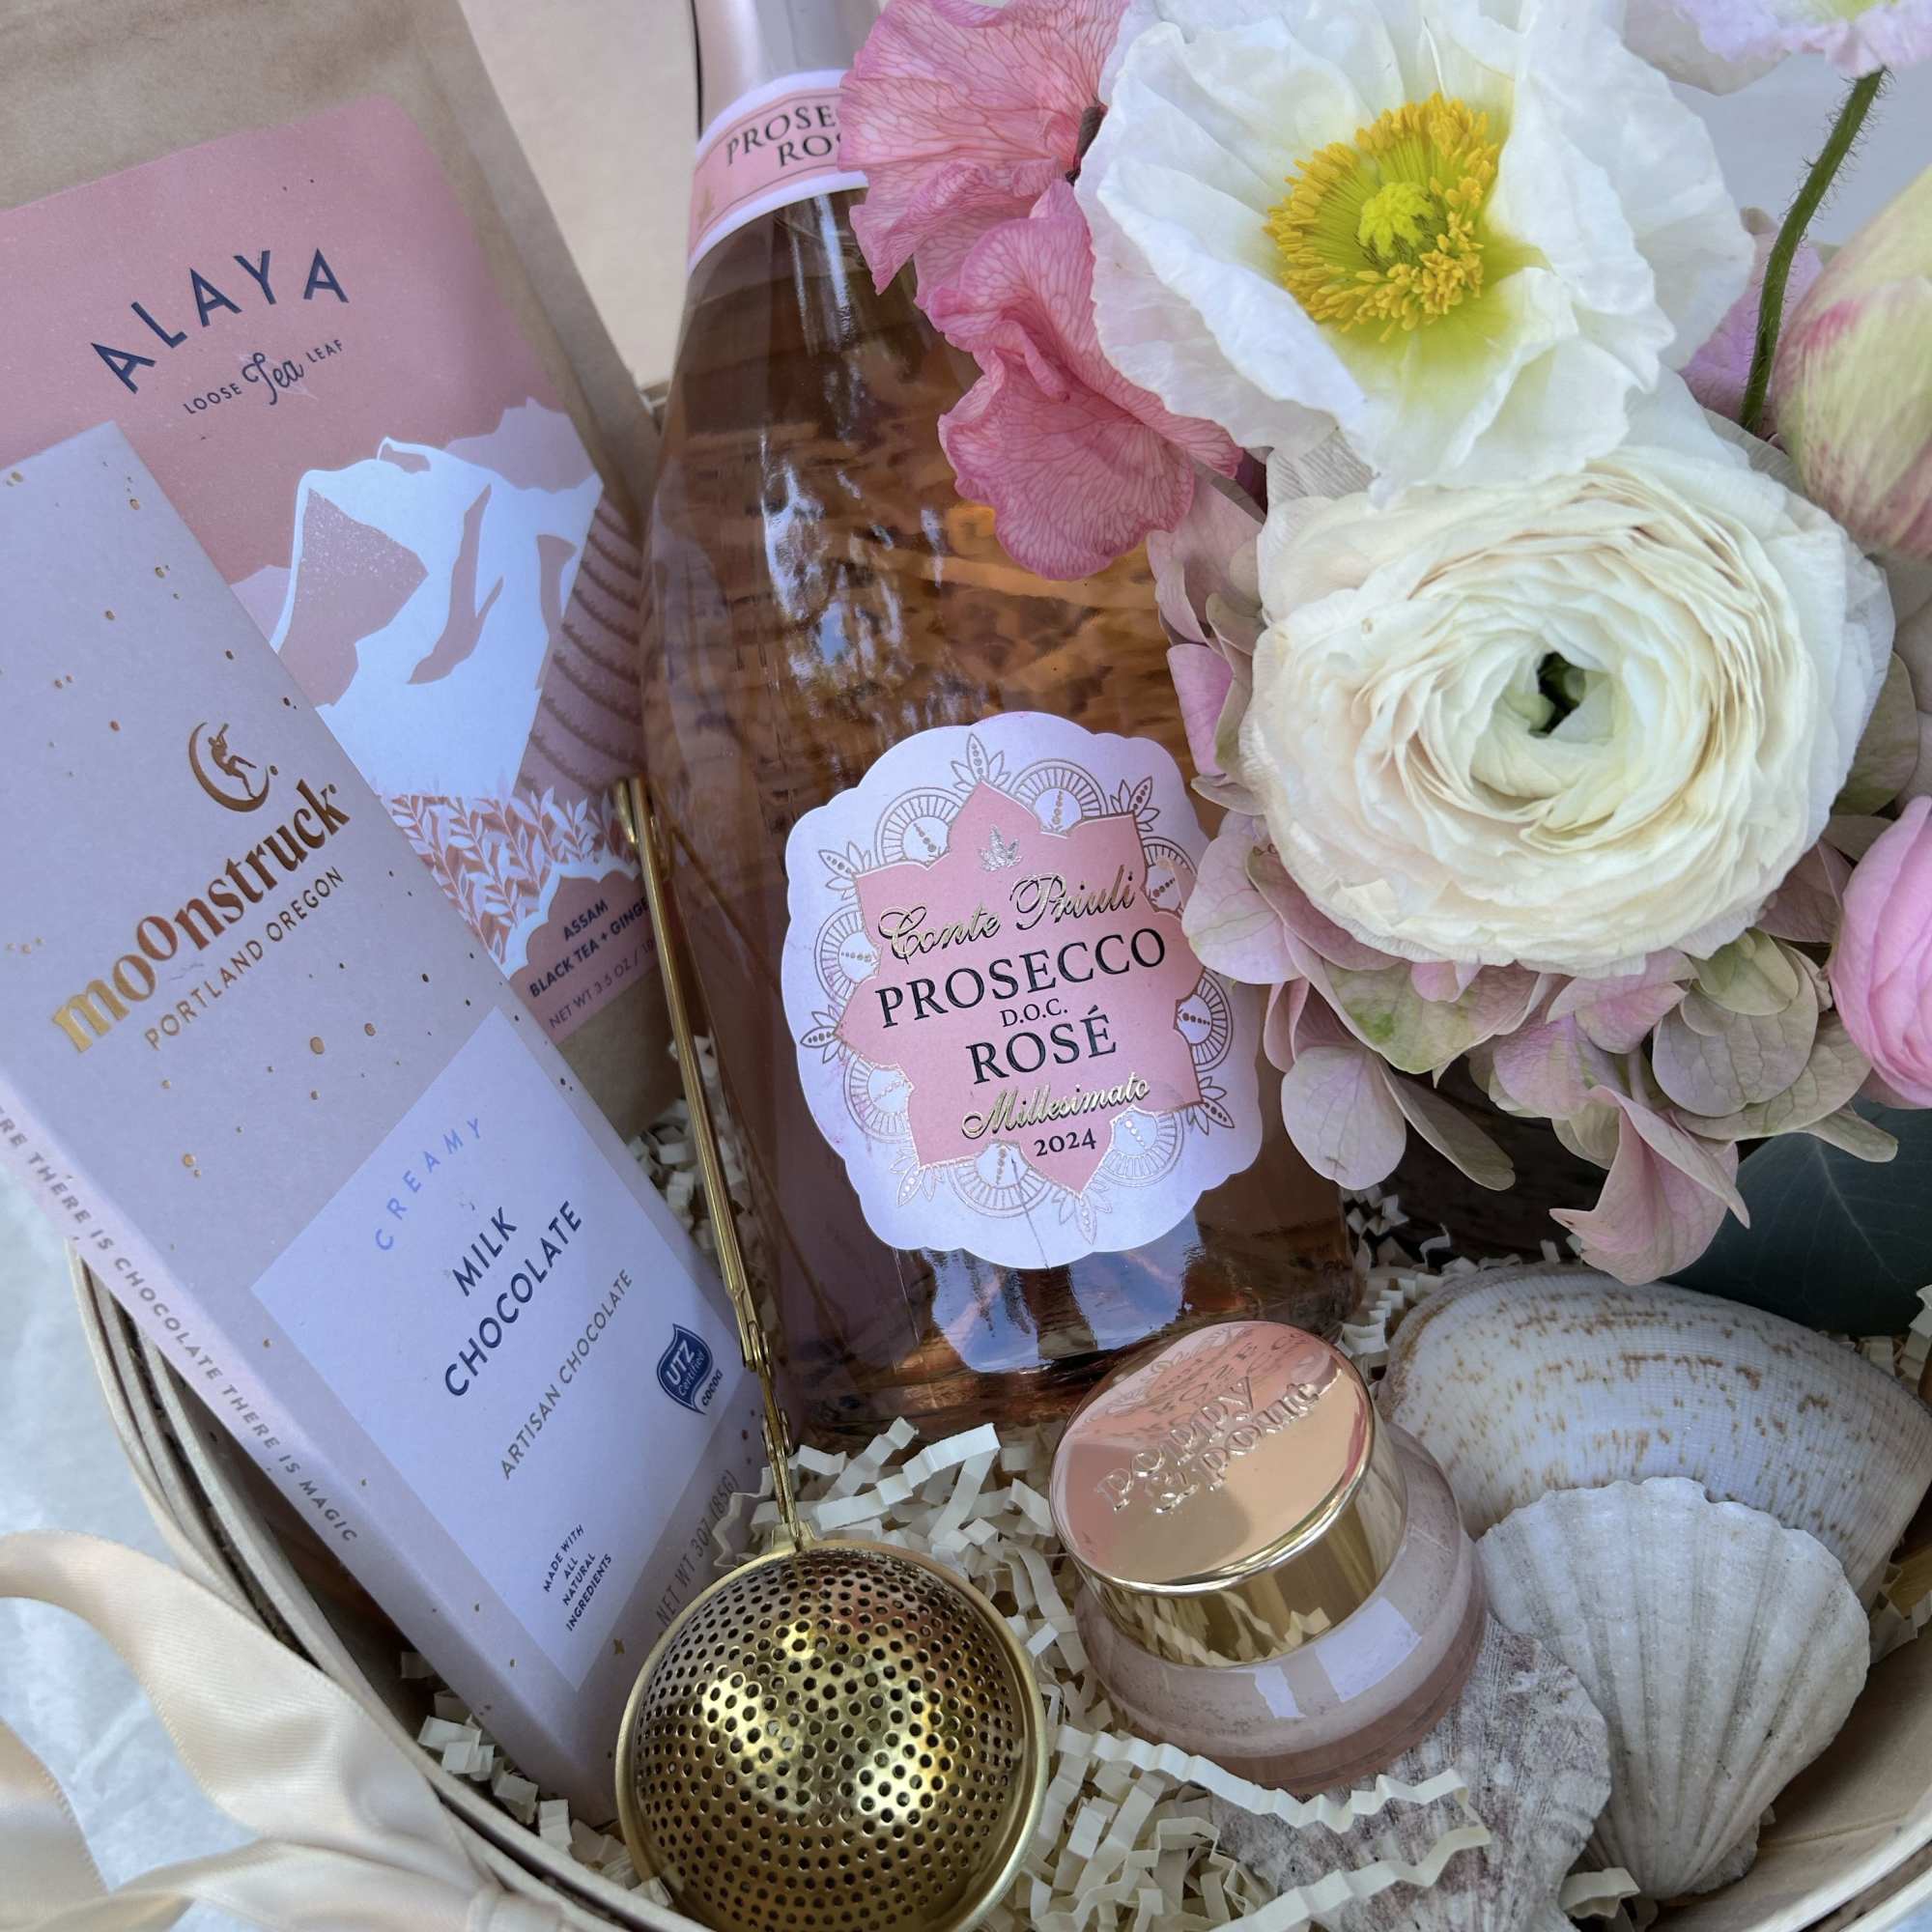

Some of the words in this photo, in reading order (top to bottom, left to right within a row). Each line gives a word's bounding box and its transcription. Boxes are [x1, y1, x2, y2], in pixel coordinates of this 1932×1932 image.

[727, 104, 838, 166] PROSE
[778, 132, 841, 167] RO
[91, 247, 350, 394] ALAYA
[183, 383, 242, 414] LOOSE
[242, 352, 305, 406] Tea
[305, 338, 344, 363] LEAF
[51, 779, 351, 1053] moonstruck
[563, 898, 609, 941] ASSAM
[878, 904, 1002, 964] Conte
[1009, 865, 1136, 930] Priuli
[145, 940, 264, 1051] PORTLAND
[266, 866, 344, 943] OREGON
[529, 957, 574, 998] BLACK
[574, 938, 600, 963] TEA
[549, 1005, 572, 1029] NET
[573, 988, 593, 1008] WT
[613, 957, 633, 978] OZ
[875, 927, 1166, 1029] PROSECCO
[965, 1004, 1117, 1085] ROSÉ
[1001, 998, 1068, 1028] D.O.C.
[961, 1071, 1151, 1140] Millesimato
[1034, 1127, 1096, 1157] 2024
[375, 1117, 483, 1251] CREAMY
[452, 1206, 518, 1297] MILK
[0, 1105, 28, 1148] RE
[28, 1151, 92, 1224] THERE
[90, 1229, 115, 1250] IS
[114, 1257, 223, 1379] CHOCOLATE
[222, 1384, 280, 1449] THERE
[278, 1454, 300, 1473] IS
[298, 1480, 357, 1541] MAGIC
[444, 1200, 582, 1396] CHOCOLATE
[500, 1383, 561, 1480] ARTISAN
[559, 1268, 634, 1384] CHOCOLATE
[666, 1339, 695, 1385] UTZ
[678, 1350, 705, 1397] Certified
[543, 1552, 563, 1592] MADE
[560, 1523, 584, 1552] WITH
[562, 1552, 596, 1606] NATURAL
[563, 1557, 579, 1579] ALL
[566, 1553, 612, 1632] INGREDIENTS
[656, 1584, 681, 1627] NET
[675, 1552, 696, 1588] WT
